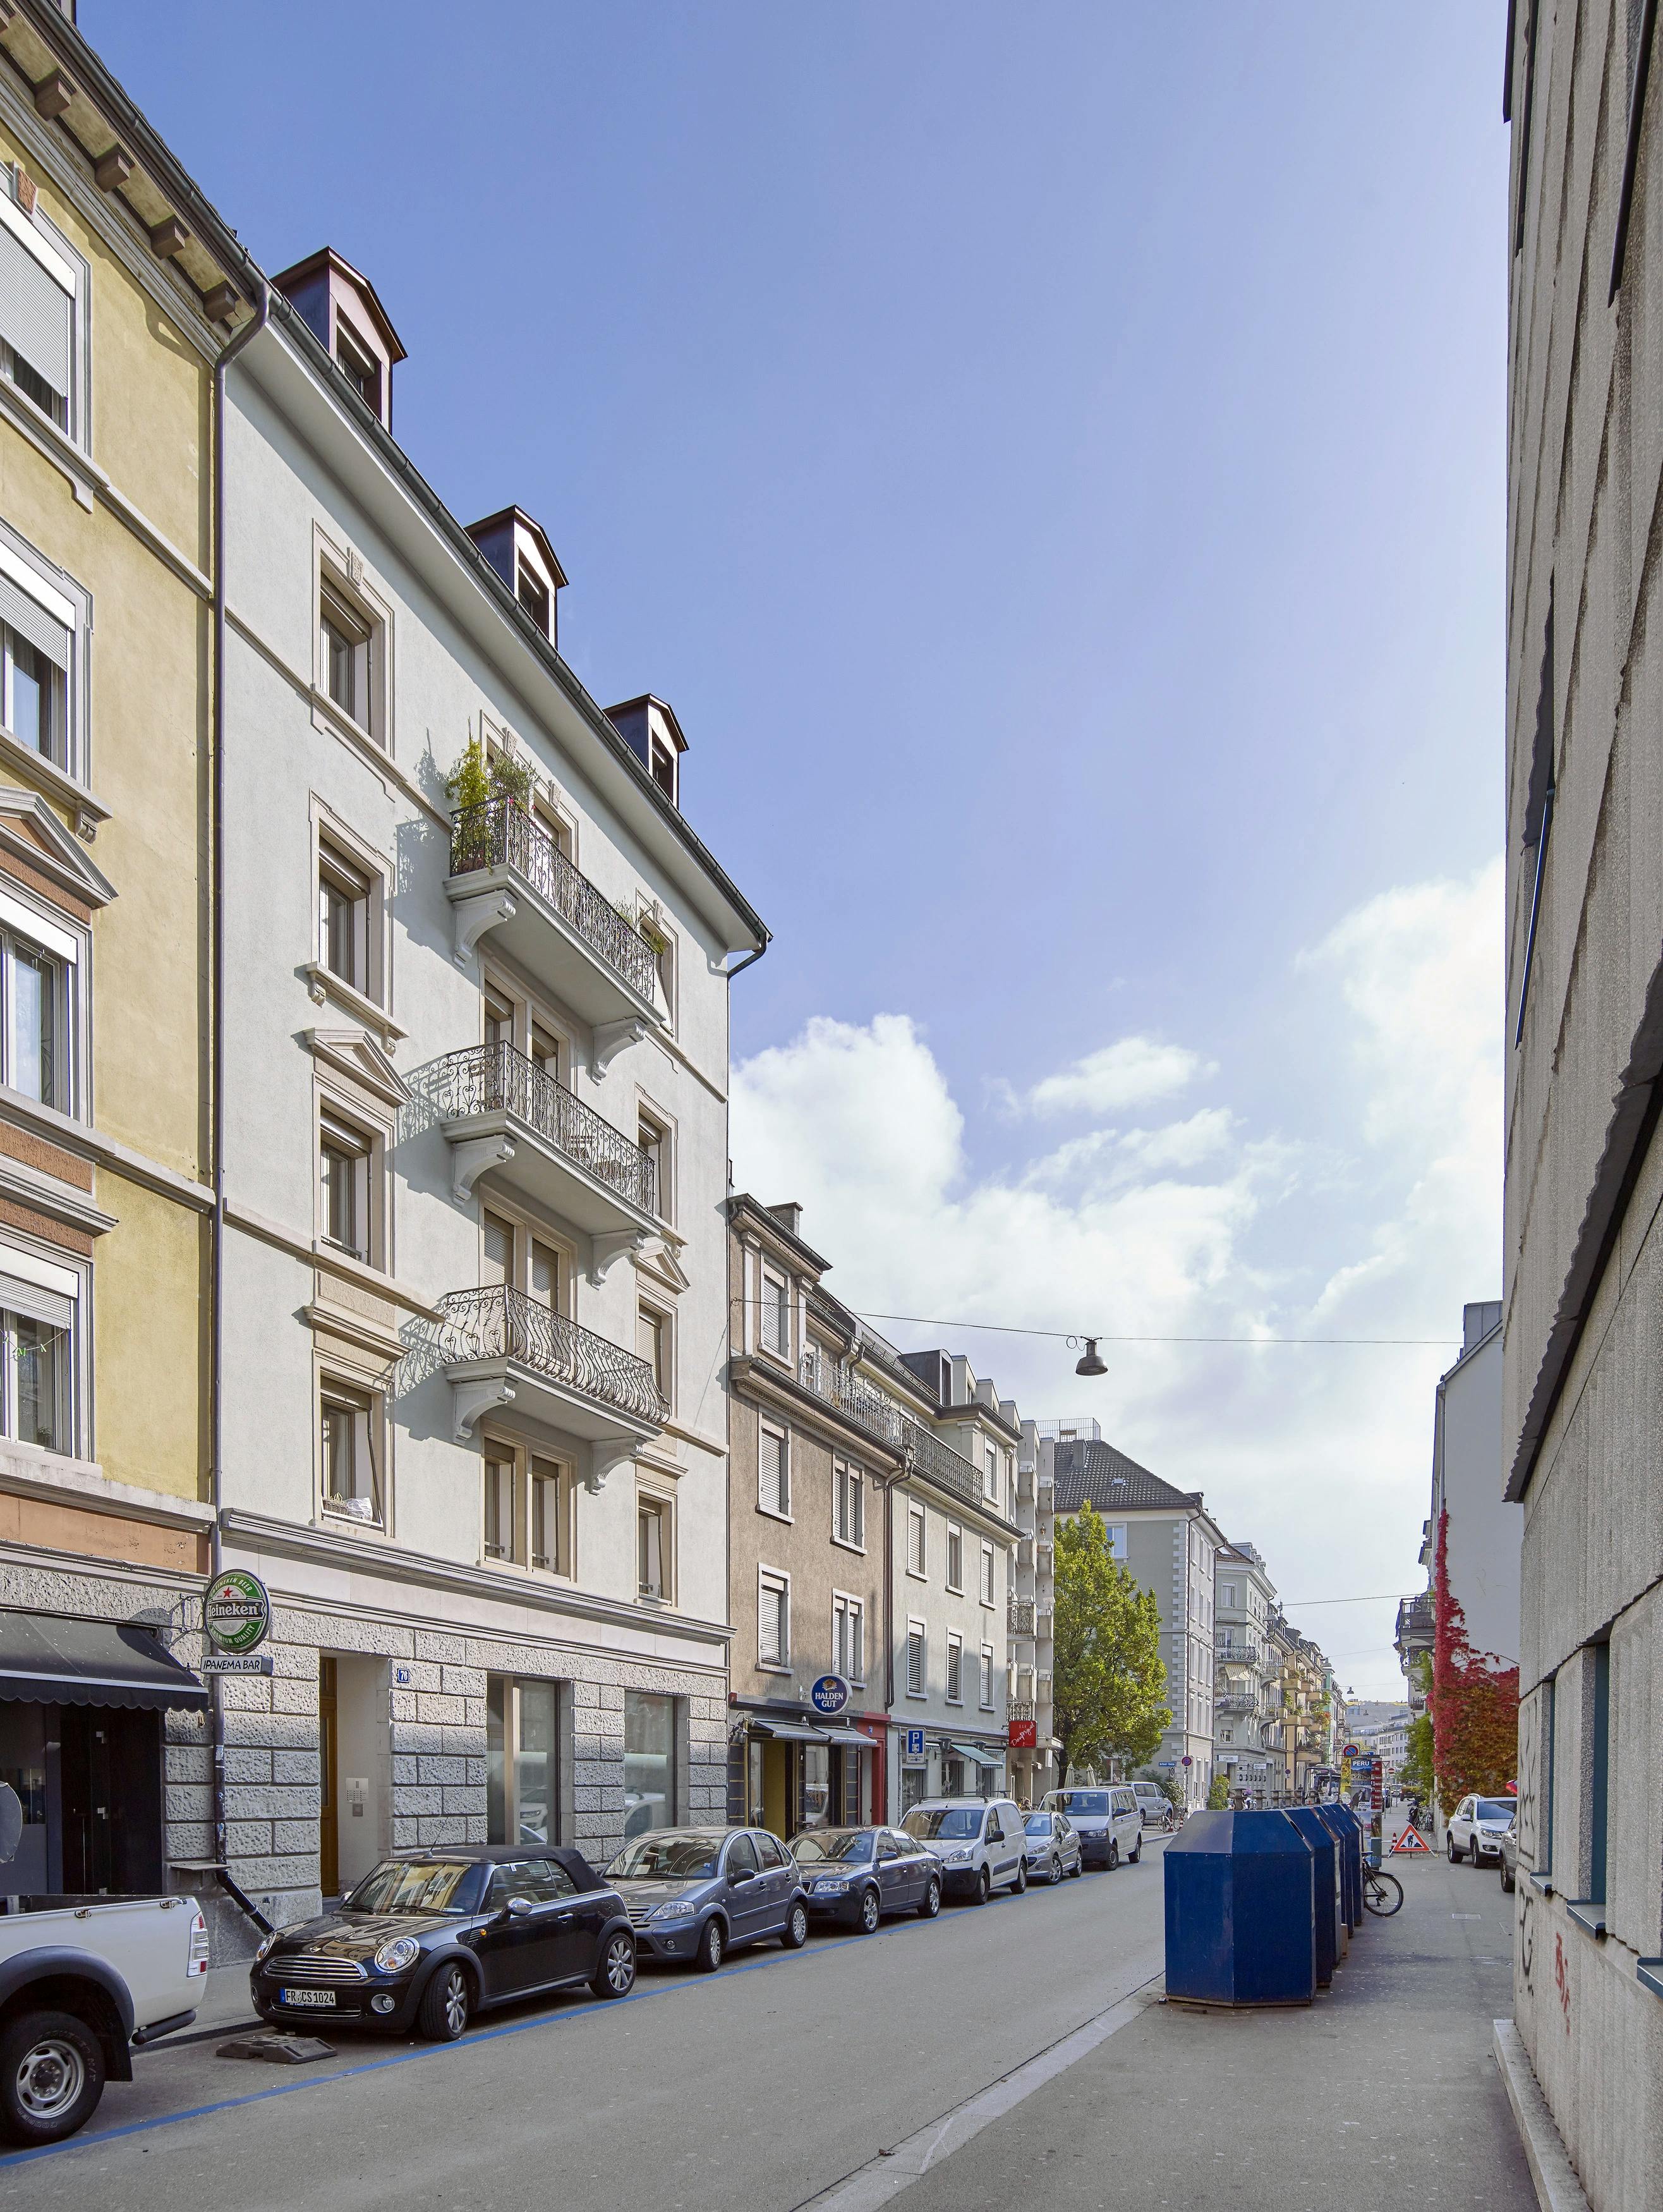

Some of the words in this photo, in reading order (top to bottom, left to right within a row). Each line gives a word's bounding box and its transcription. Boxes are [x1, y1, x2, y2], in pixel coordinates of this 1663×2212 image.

[212, 1577, 238, 1594] HEINEKEN
[238, 1579, 253, 1592] BEER
[207, 1603, 258, 1617] Heineken
[211, 1626, 234, 1644] PREMIUM
[234, 1624, 255, 1644] QUALITY
[203, 1660, 241, 1670] IPANEMA
[243, 1660, 260, 1670] BAR
[815, 1692, 844, 1700] HALDEN
[912, 1732, 919, 1743] P
